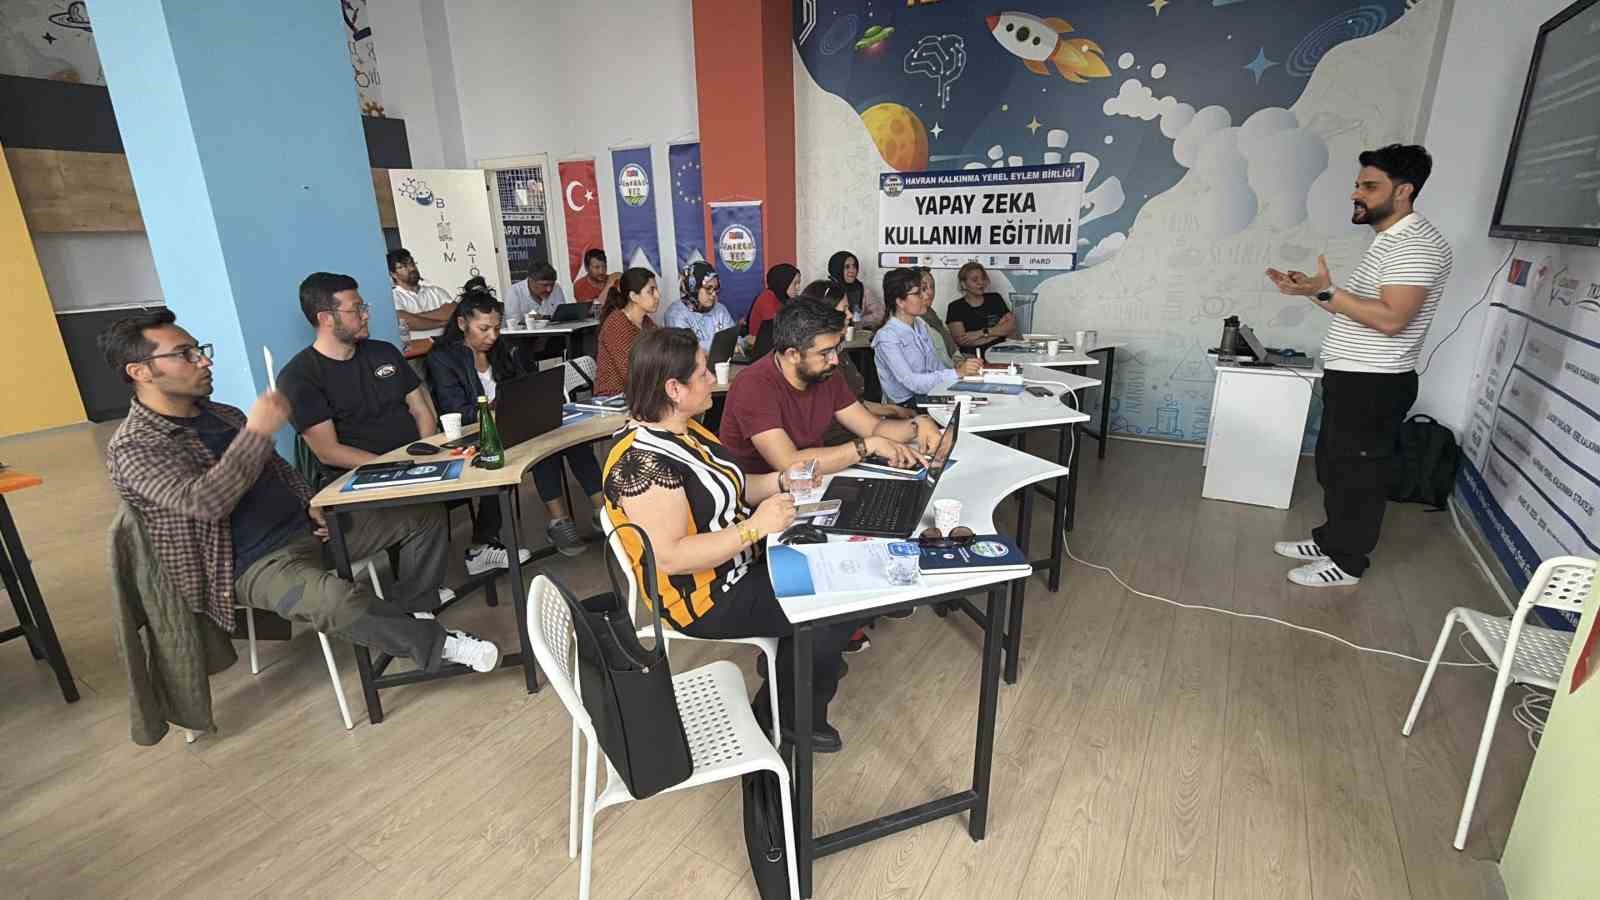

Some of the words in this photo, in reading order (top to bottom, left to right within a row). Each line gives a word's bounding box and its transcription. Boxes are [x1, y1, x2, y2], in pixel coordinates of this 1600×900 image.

[905, 176, 937, 185] HAVRAN
[938, 174, 980, 183] KALKINMA
[981, 172, 1009, 182] YEREL
[1010, 171, 1040, 180] EYLEM
[1041, 167, 1076, 179] BİRLİĞİ
[915, 193, 976, 216] YAPAY
[981, 191, 1036, 214] ZEKA
[523, 224, 541, 235] ZEKA
[884, 224, 982, 245] KULLANIM
[989, 218, 1072, 246] EĞİTİMİ
